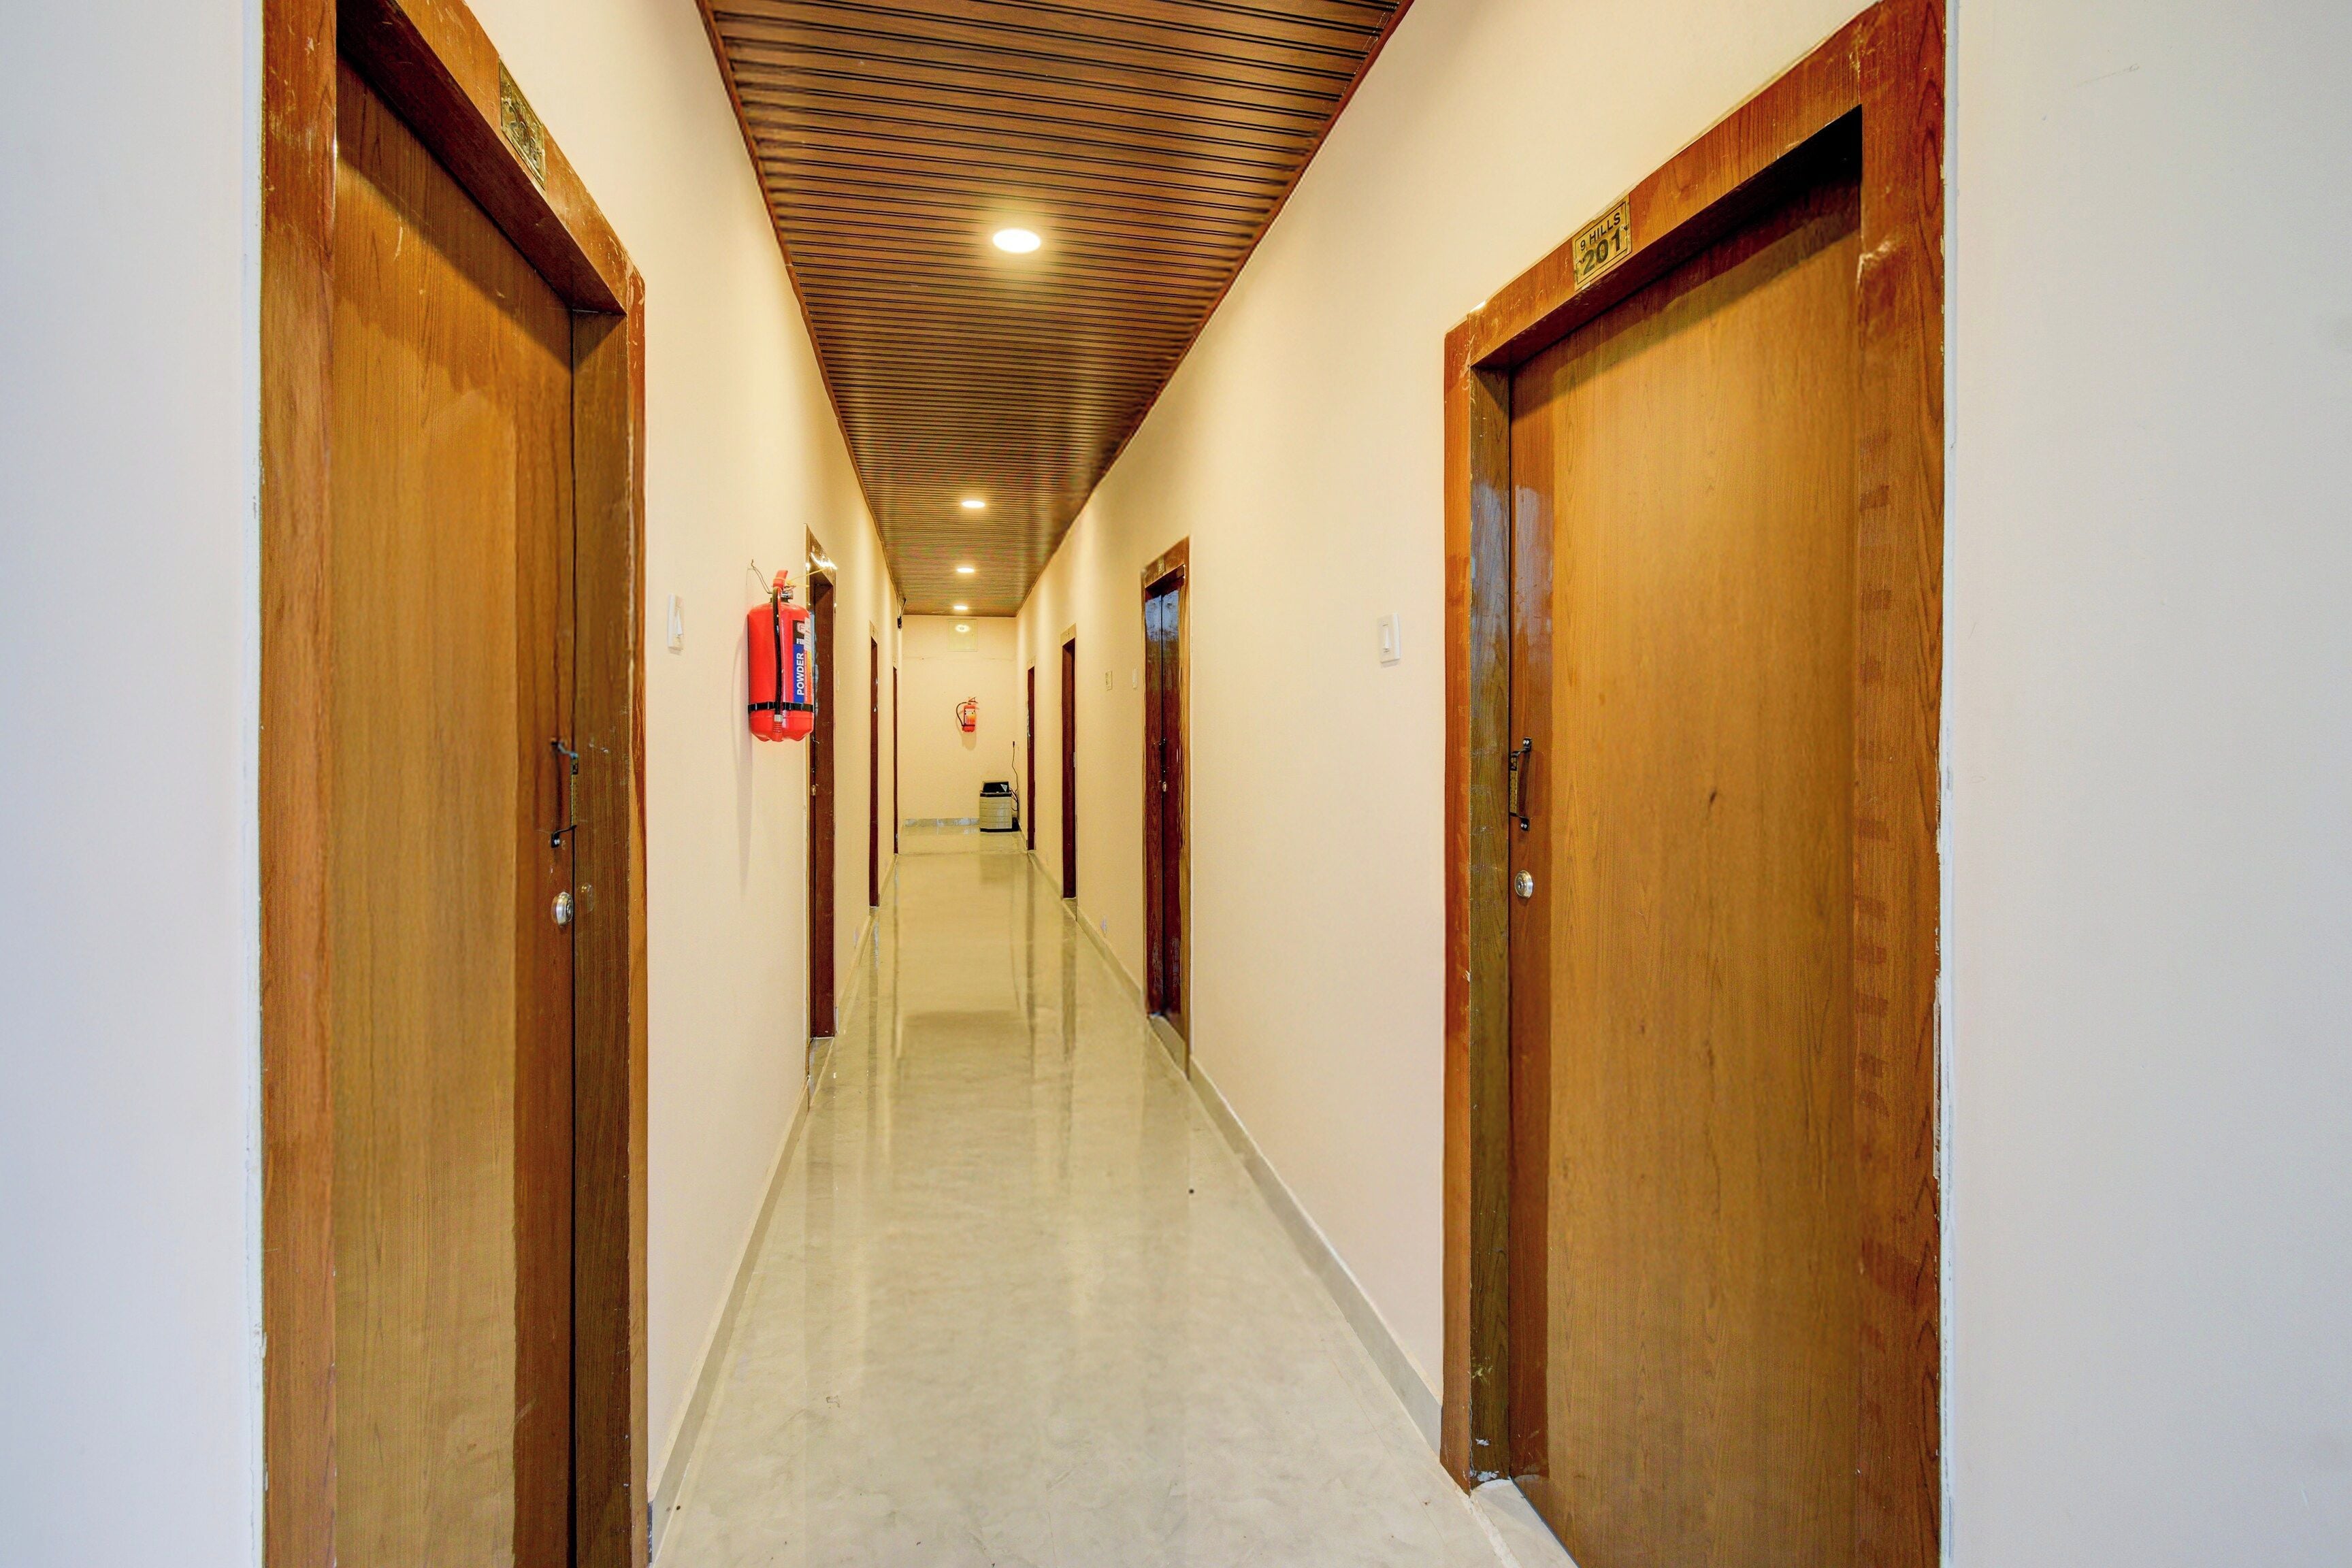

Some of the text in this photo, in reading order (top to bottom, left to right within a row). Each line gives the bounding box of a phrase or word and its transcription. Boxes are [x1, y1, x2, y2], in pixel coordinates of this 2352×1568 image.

[1580, 212, 1620, 251] 9 HILLS
[1583, 227, 1620, 276] 201
[796, 652, 804, 696] POWDER
